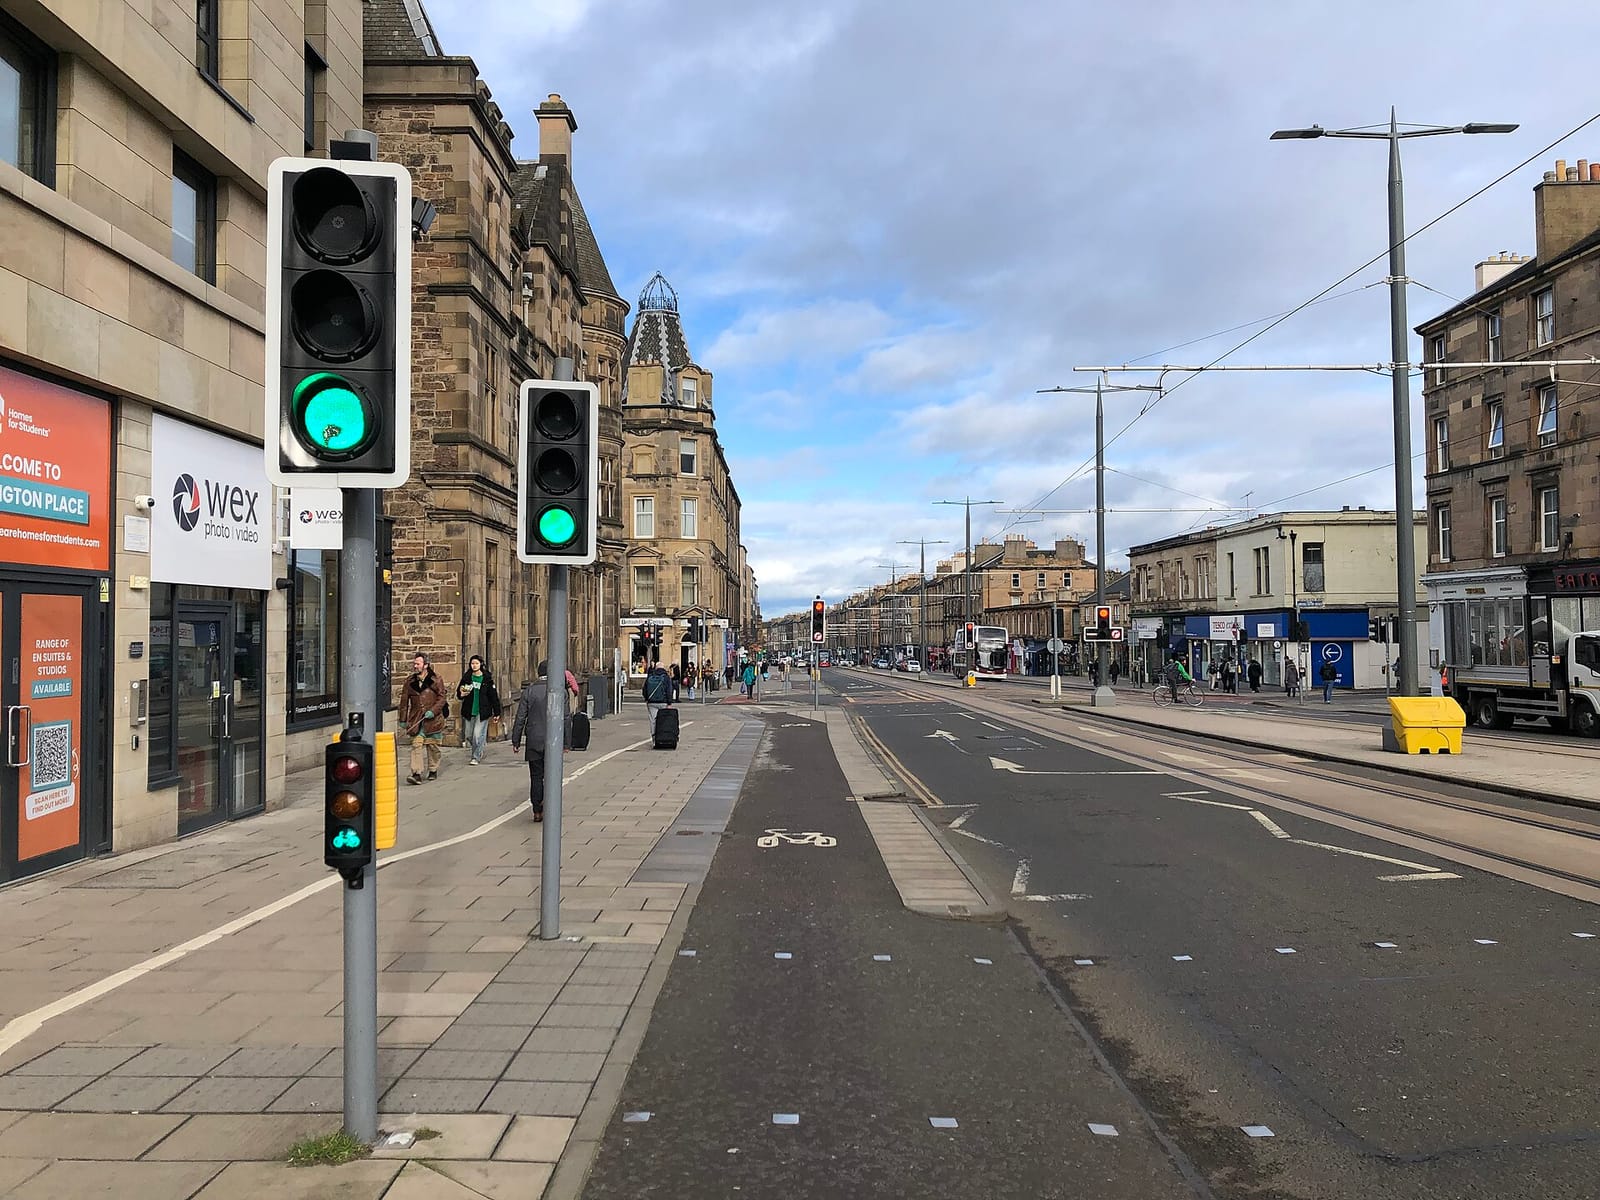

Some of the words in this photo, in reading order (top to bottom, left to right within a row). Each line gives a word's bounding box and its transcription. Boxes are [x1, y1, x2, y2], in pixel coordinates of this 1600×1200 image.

[8, 407, 33, 423] Homes
[8, 418, 18, 429] for
[0, 453, 42, 477] COME
[44, 462, 61, 481] TO
[45, 492, 84, 516] PLACE
[204, 479, 259, 525] wex
[204, 519, 231, 539] photo
[235, 526, 259, 543] video
[1212, 621, 1225, 629] TESCO
[35, 639, 60, 649] RANGE
[60, 639, 70, 648] OF
[32, 652, 42, 663] EN
[42, 652, 65, 662] SUITES
[66, 652, 72, 661] &
[37, 665, 67, 676] STUDIOS
[33, 682, 71, 694] AVAILABLE
[34, 794, 49, 805] SCAN
[61, 788, 68, 797] TO
[44, 801, 54, 810] OUT
